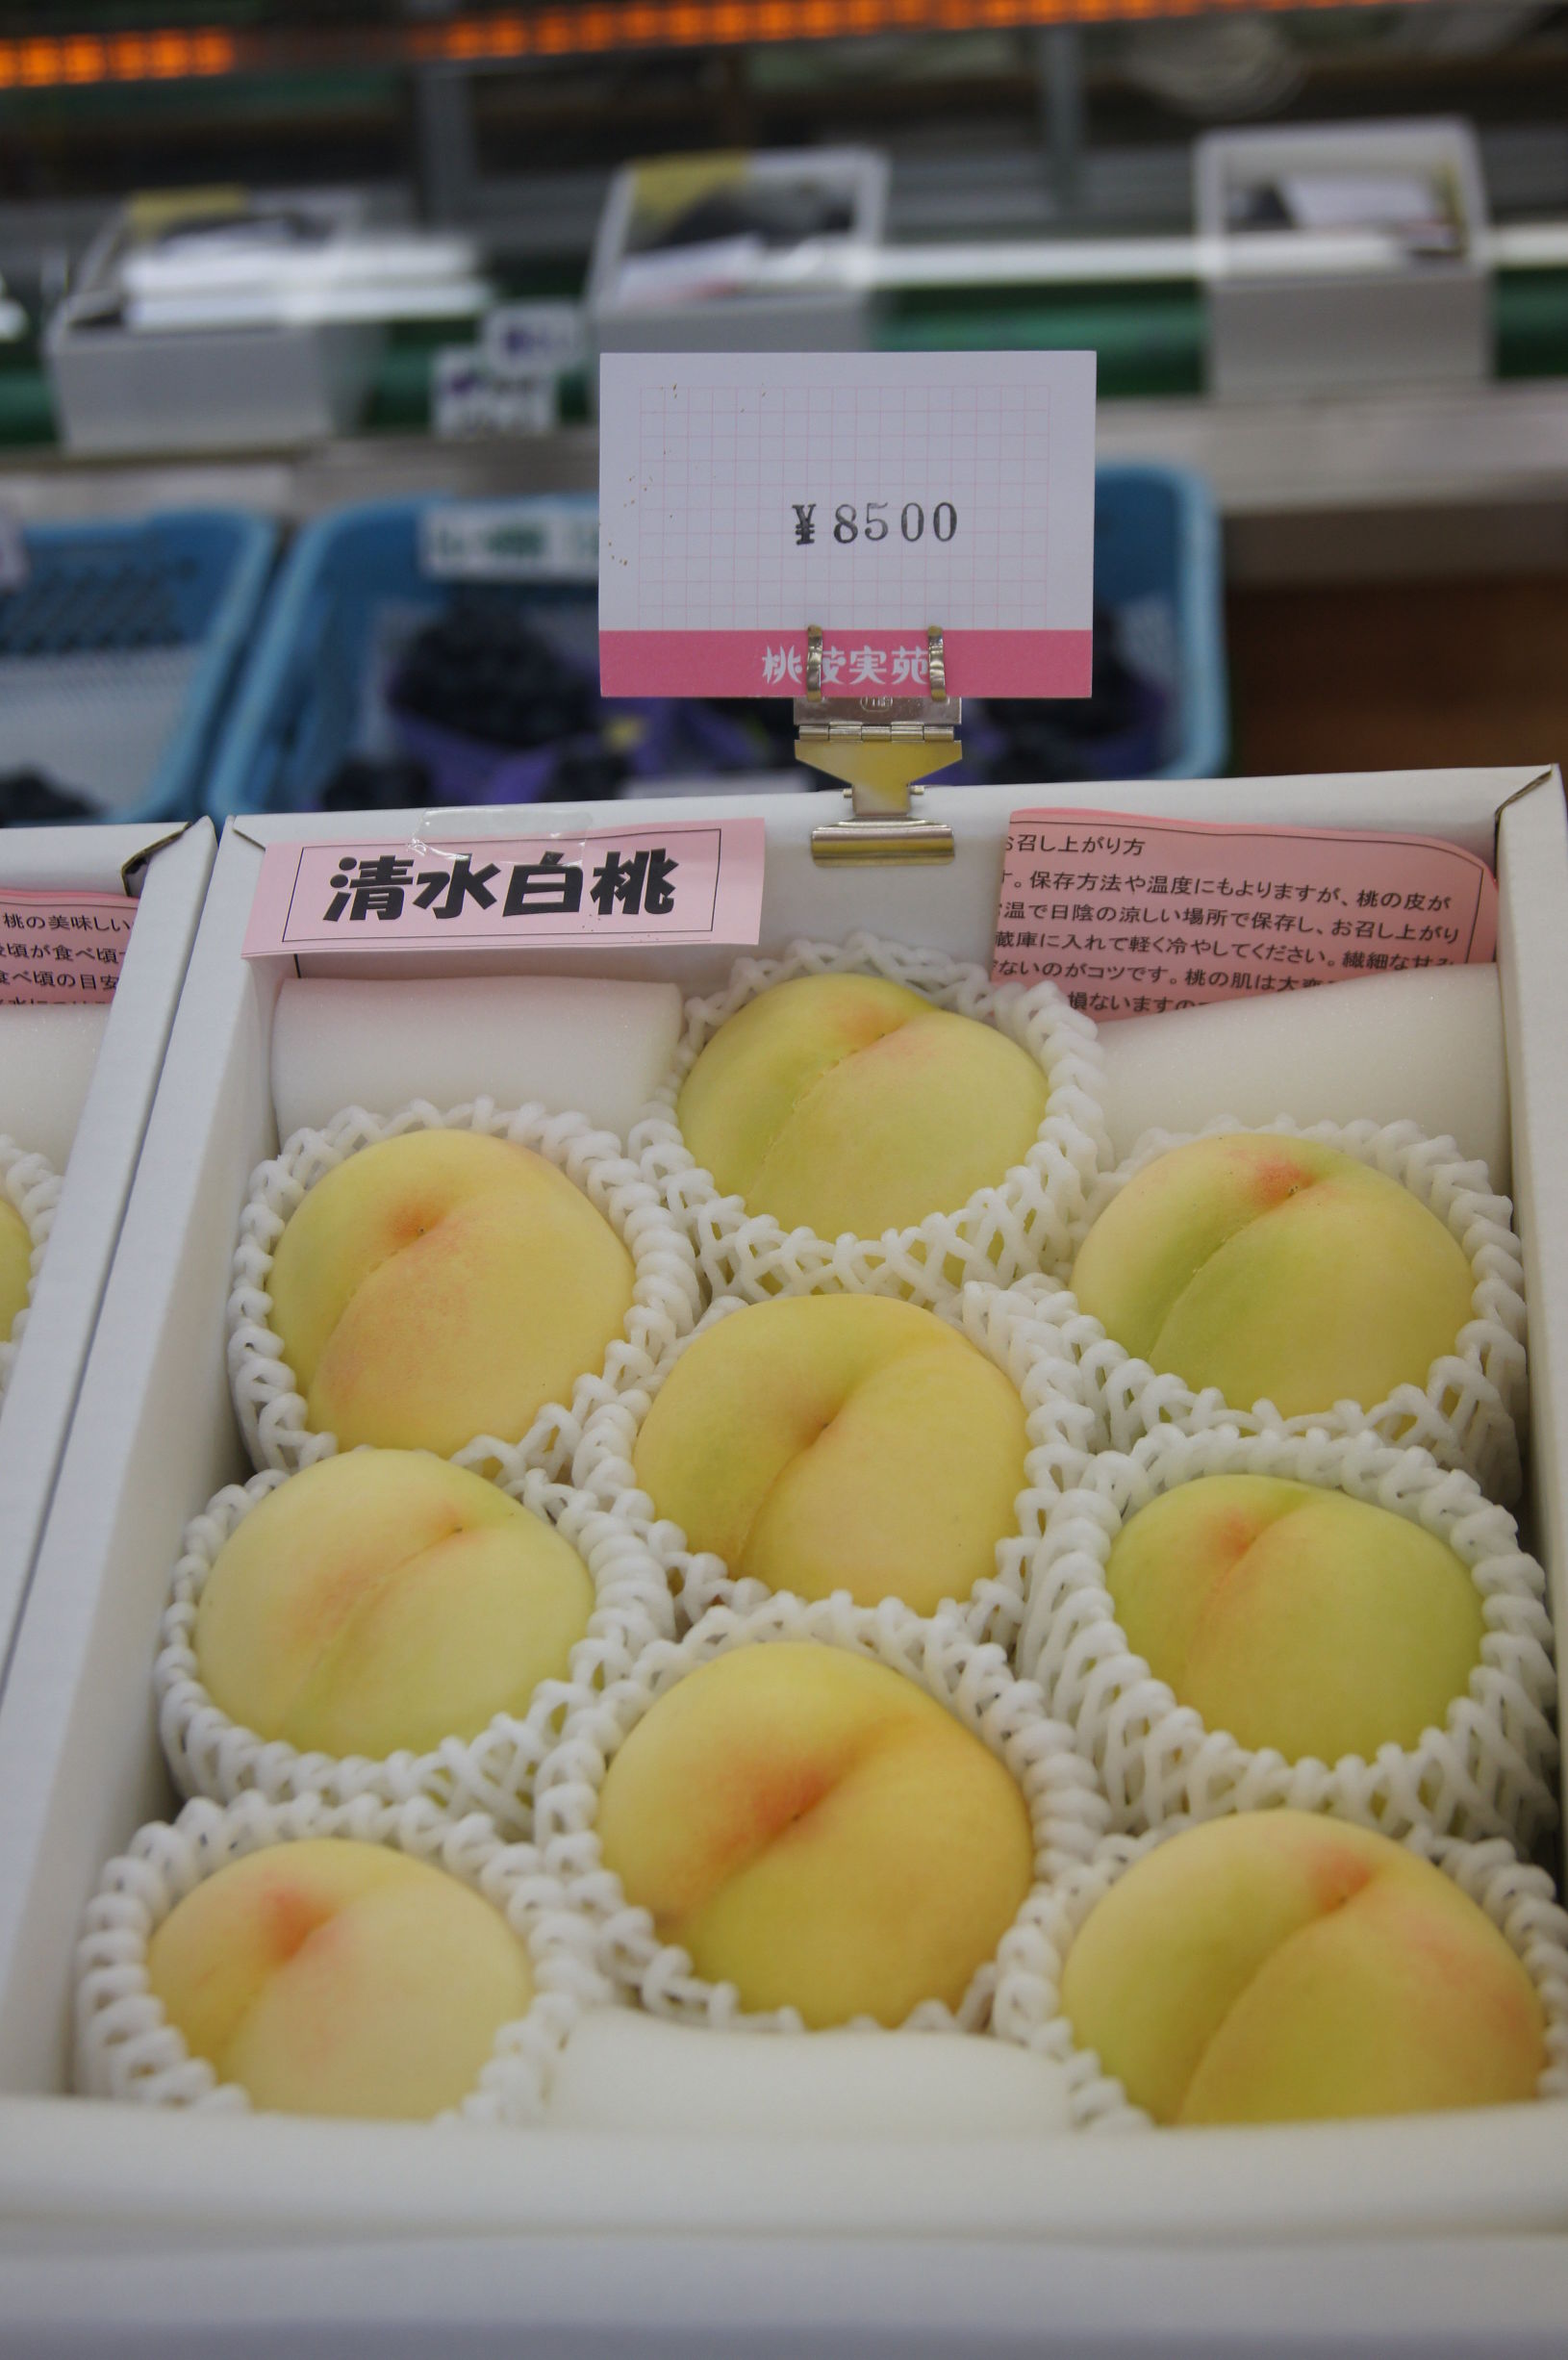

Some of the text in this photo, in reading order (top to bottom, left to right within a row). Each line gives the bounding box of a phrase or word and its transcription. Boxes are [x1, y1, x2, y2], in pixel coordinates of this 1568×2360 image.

[792, 501, 958, 546] ¥8500
[322, 848, 679, 922] 清水白桃
[999, 901, 1459, 945] 温で日陰の涼しい場所で保存し、お召し上がり
